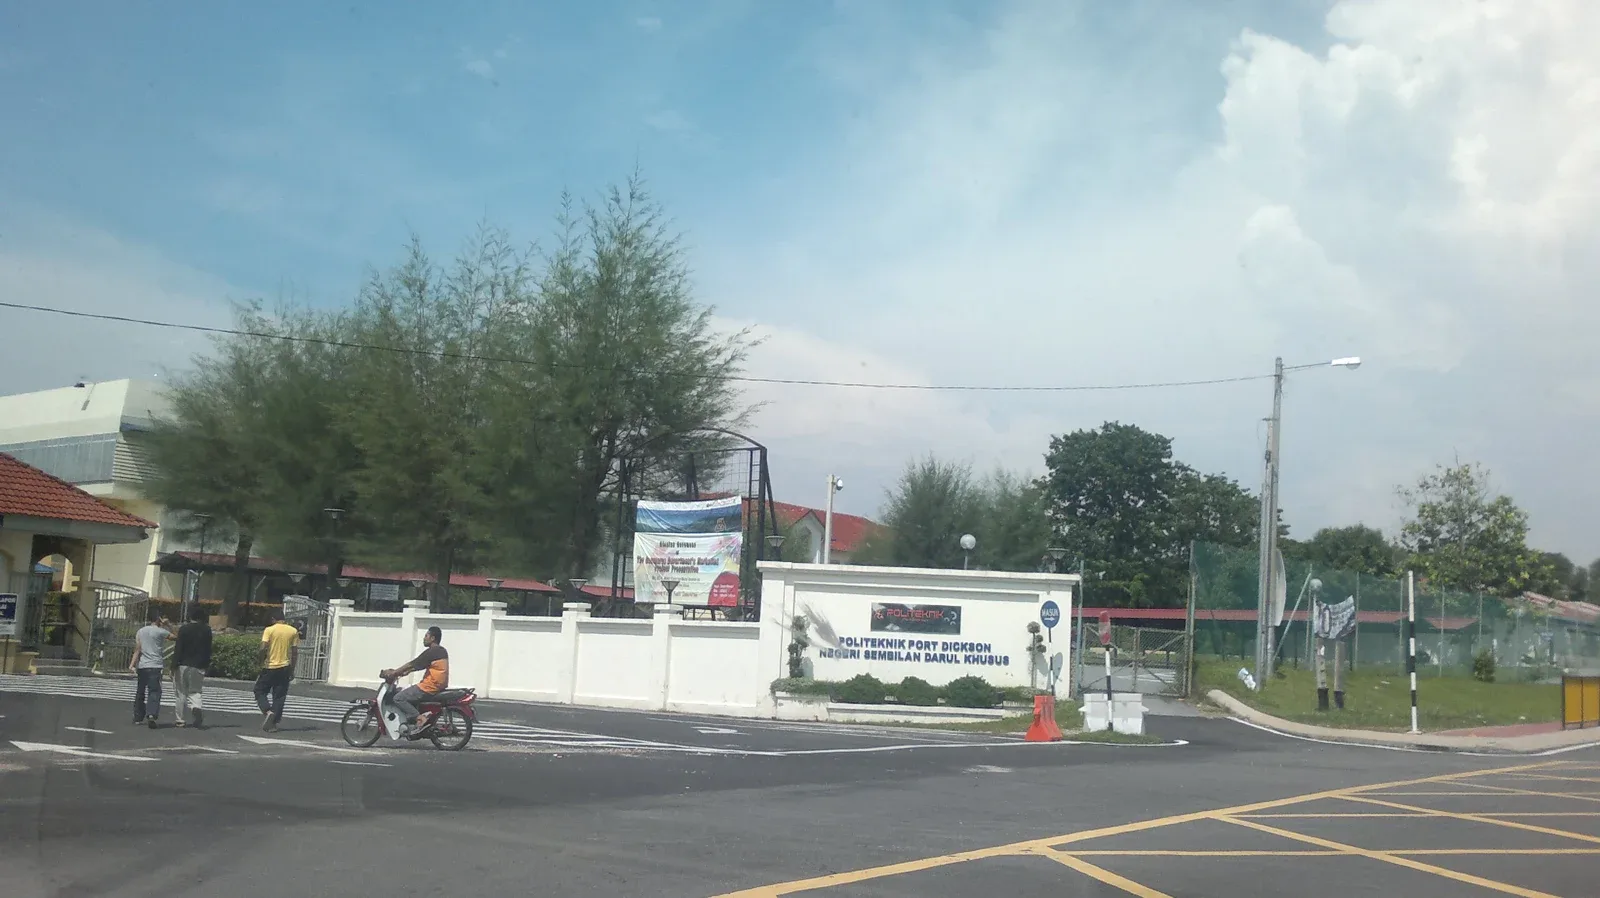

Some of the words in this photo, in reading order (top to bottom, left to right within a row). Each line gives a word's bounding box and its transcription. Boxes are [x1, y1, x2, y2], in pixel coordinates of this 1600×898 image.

[886, 608, 944, 619] POLITEKNIK
[838, 636, 906, 650] POLITEKNIK
[908, 639, 938, 651] PORT
[941, 641, 991, 653] DICKSON
[819, 647, 860, 659] NEGERI
[864, 649, 921, 662] SEMBILAN
[924, 653, 960, 664] DARUL
[964, 654, 1010, 666] KHUSUS
